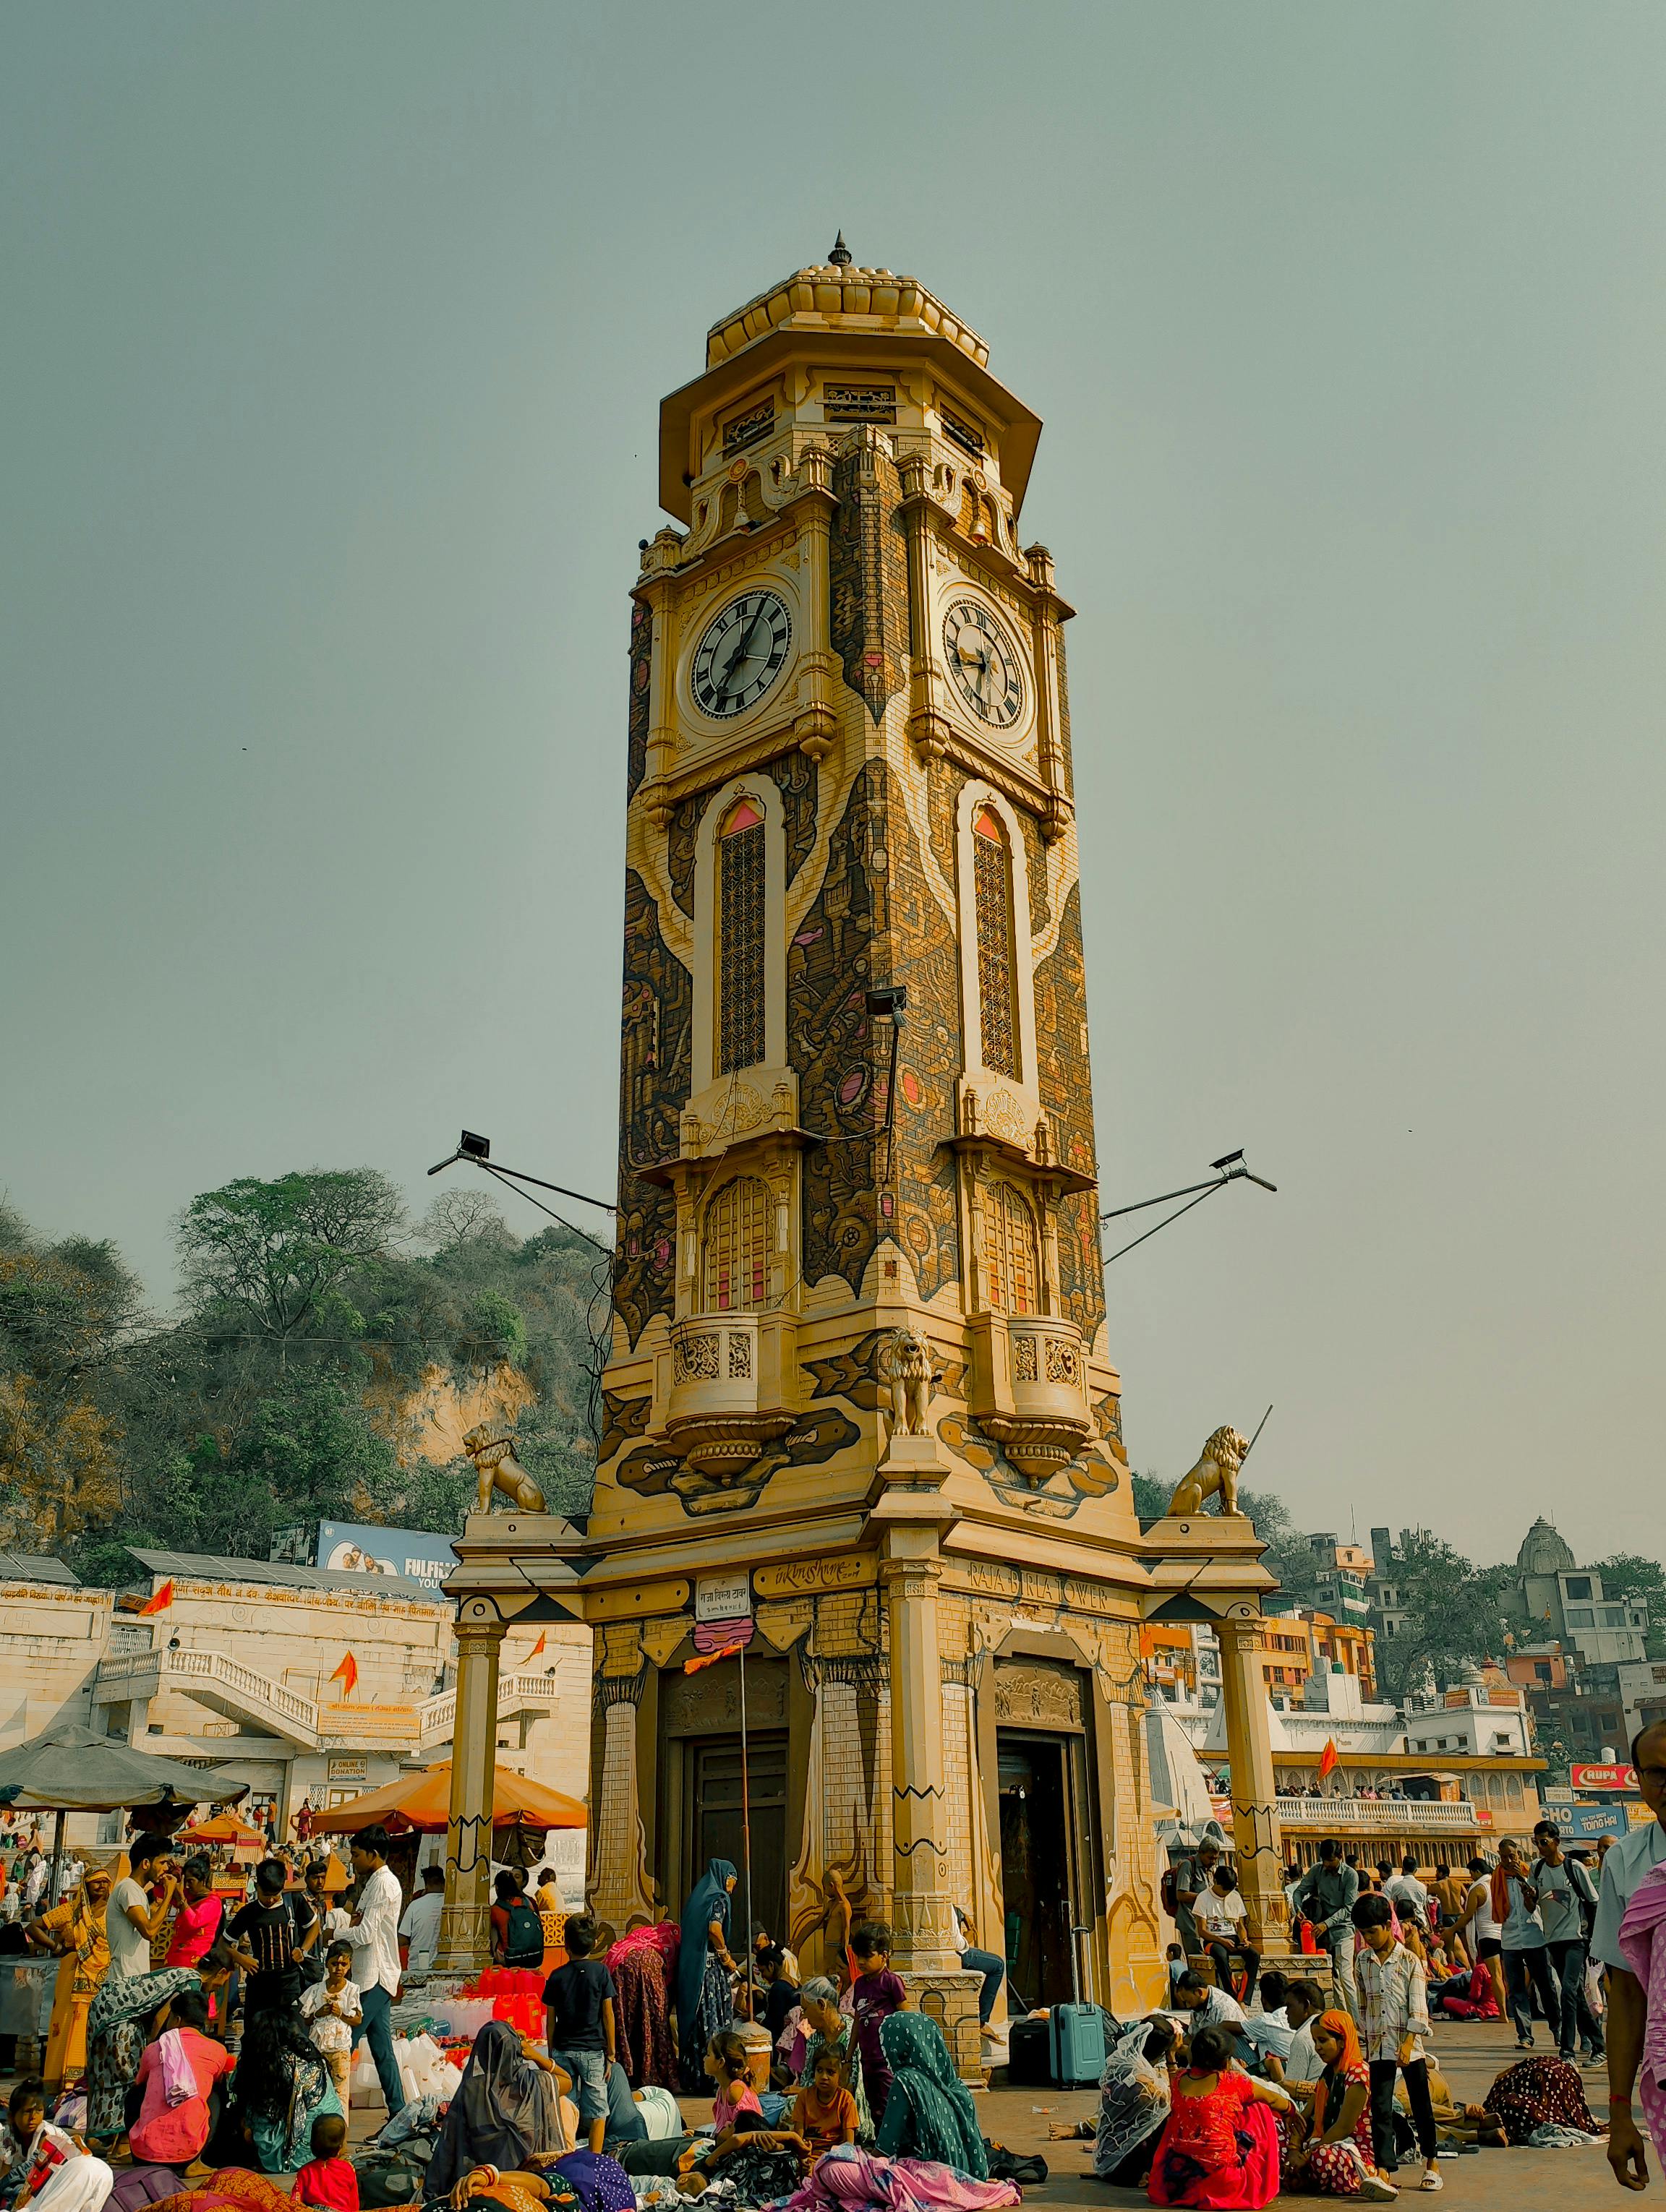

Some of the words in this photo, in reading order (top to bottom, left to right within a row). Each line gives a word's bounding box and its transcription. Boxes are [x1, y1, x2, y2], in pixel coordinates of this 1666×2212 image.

[405, 1558, 460, 1579] FULFIL
[418, 1577, 440, 1590] YOU
[969, 1561, 1005, 1592] RAJA
[1008, 1569, 1053, 1600] BIRLA
[1055, 1577, 1107, 1610] TOWER
[700, 1592, 714, 1603] राजा
[732, 1587, 746, 1599] टावर
[1587, 1770, 1618, 1780] RUPA
[1559, 1825, 1574, 1835] RTO
[1581, 1818, 1604, 1832] TOING
[1604, 1814, 1618, 1827] HAI
